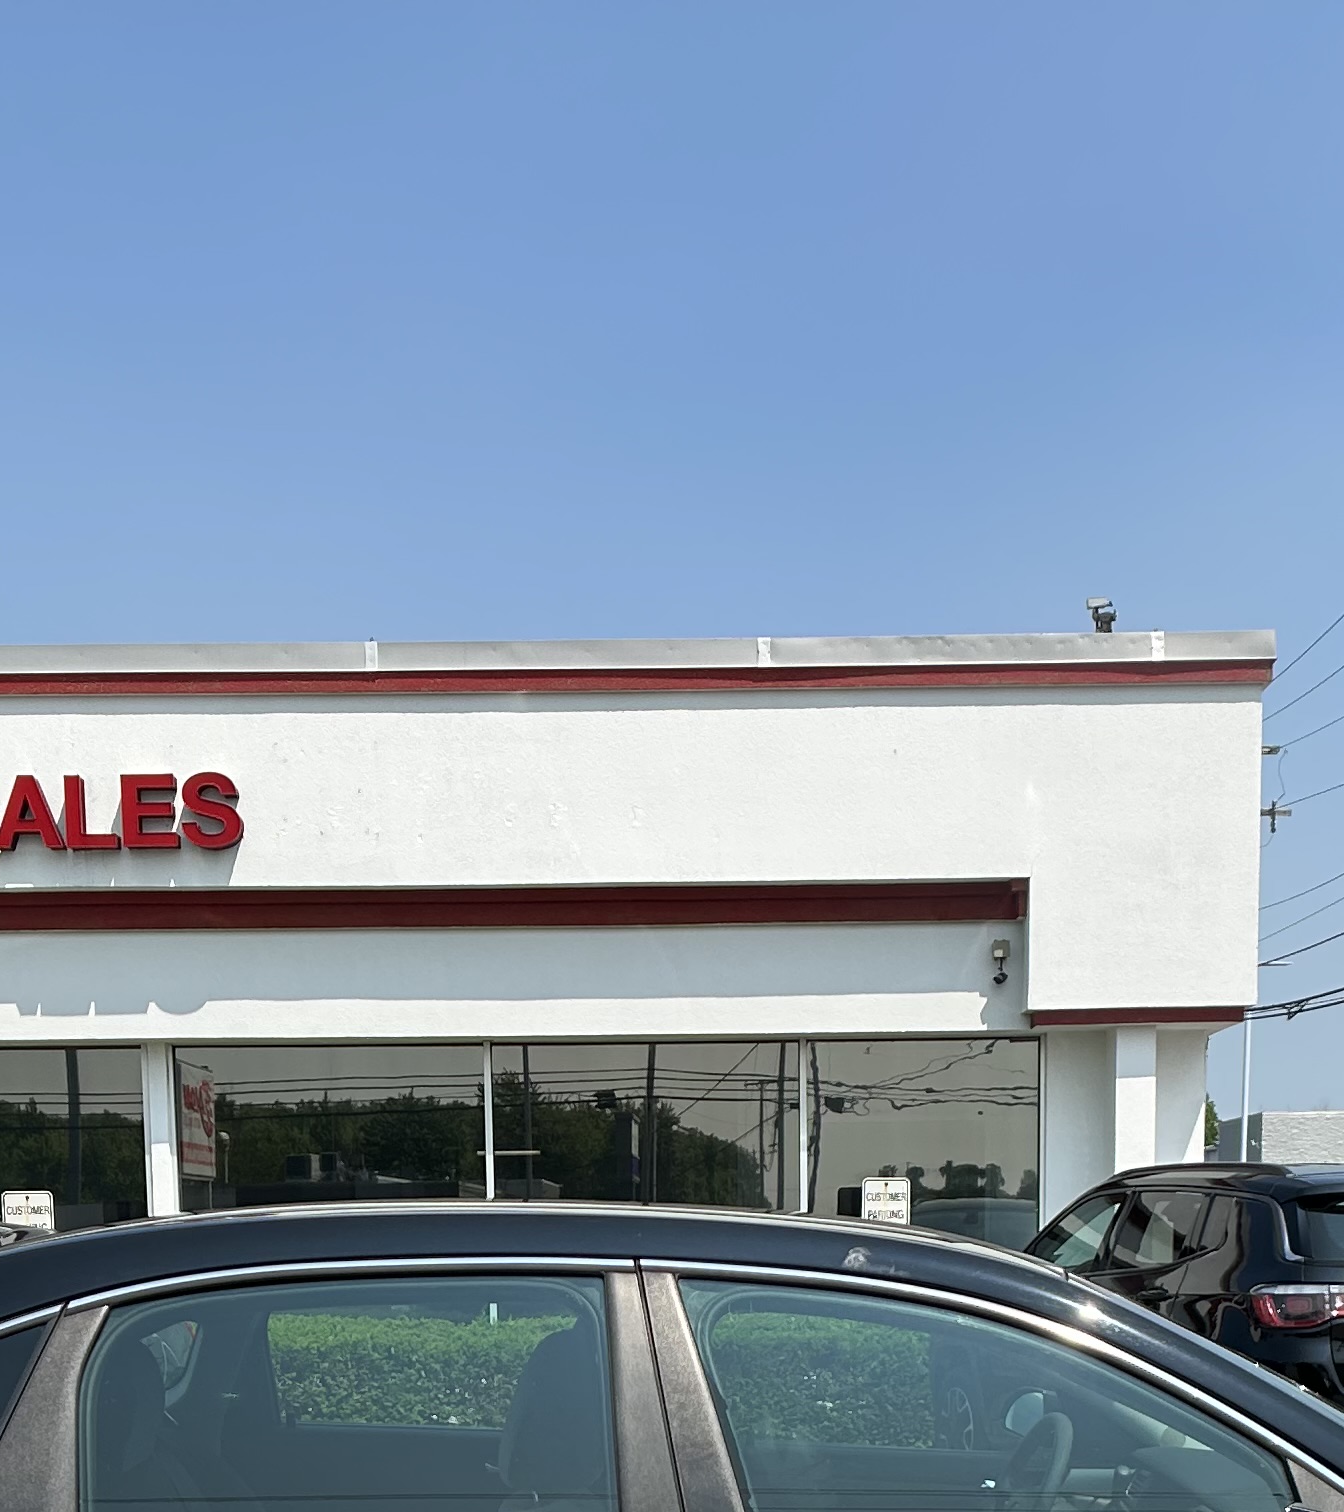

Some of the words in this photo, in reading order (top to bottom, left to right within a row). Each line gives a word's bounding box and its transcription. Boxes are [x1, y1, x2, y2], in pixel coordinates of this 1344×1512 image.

[866, 1192, 907, 1201] CUSTOMER
[6, 1205, 50, 1215] CUSTOMER
[867, 1209, 905, 1219] PARKING
